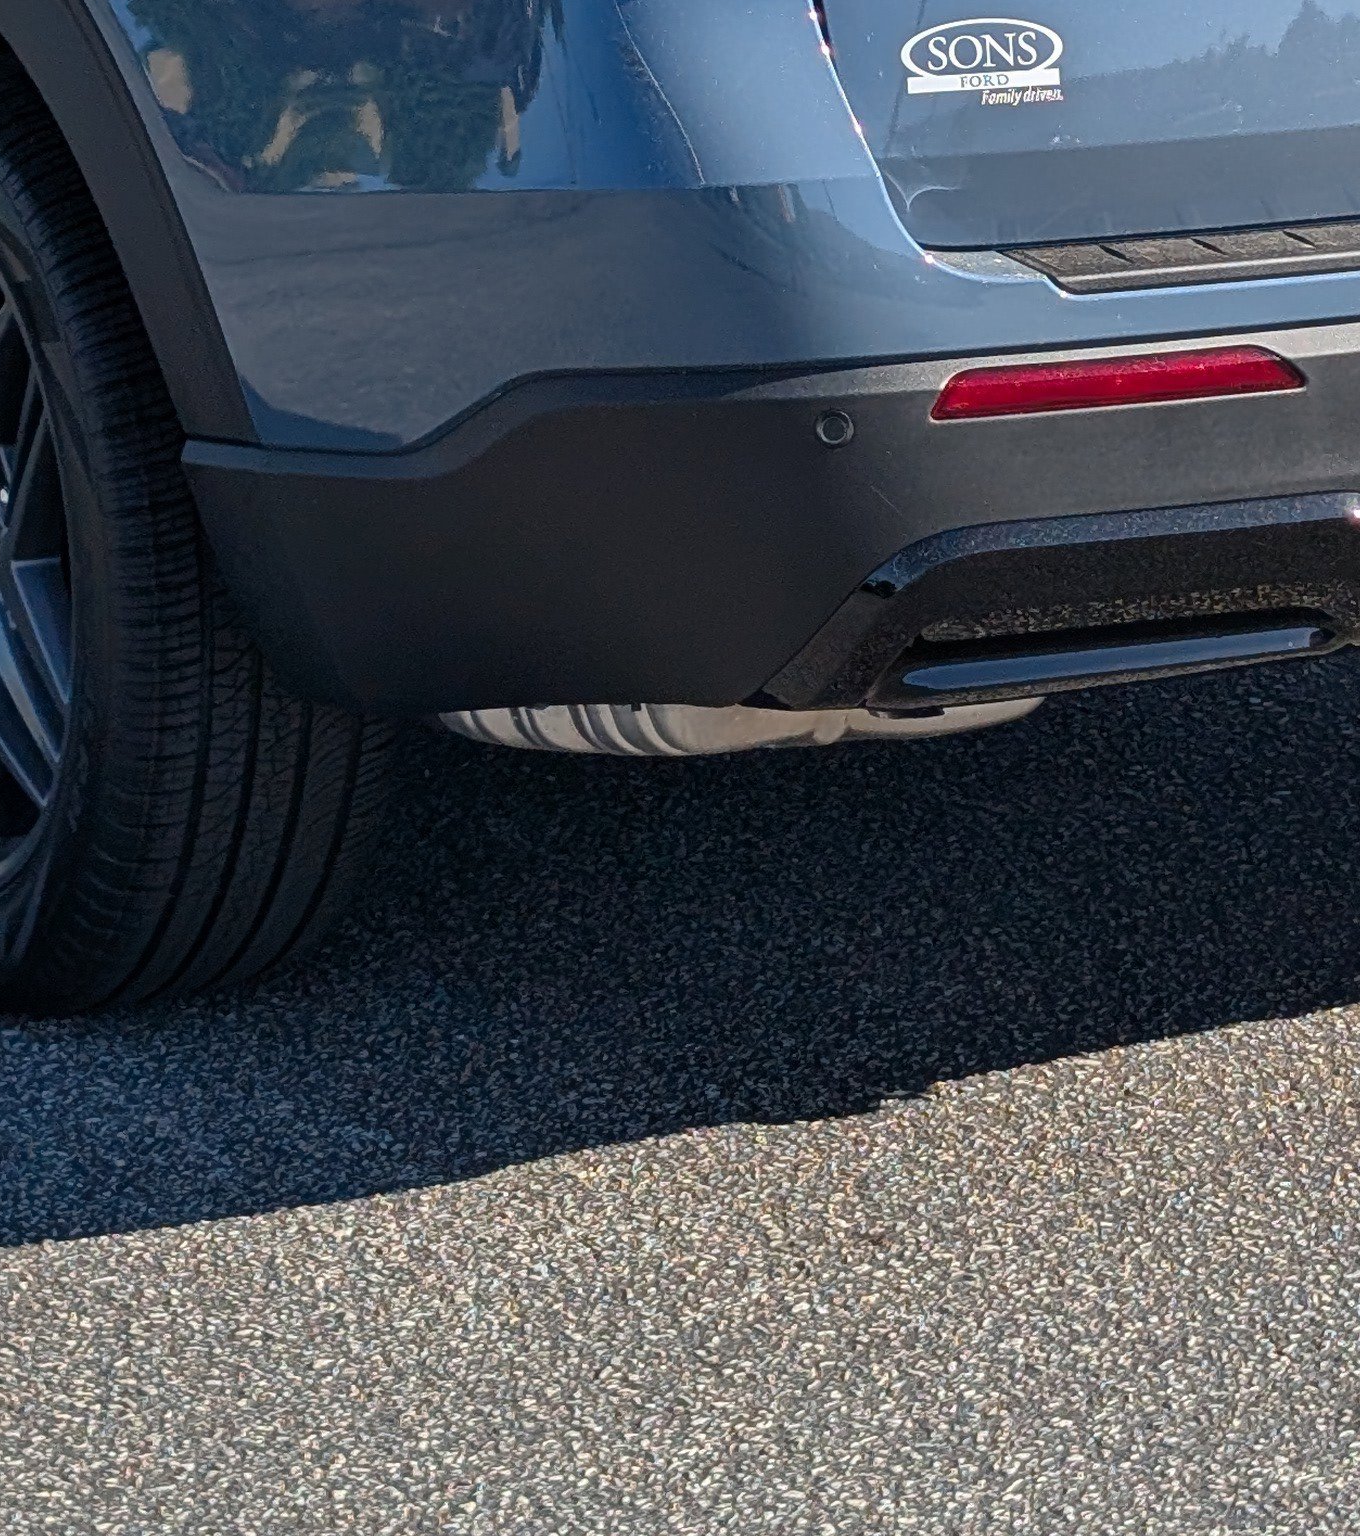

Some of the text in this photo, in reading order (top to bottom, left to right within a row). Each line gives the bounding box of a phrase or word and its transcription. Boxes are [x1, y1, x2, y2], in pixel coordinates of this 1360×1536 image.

[927, 31, 1037, 71] SONS
[960, 73, 1010, 89] FORD
[981, 89, 1022, 106] Family
